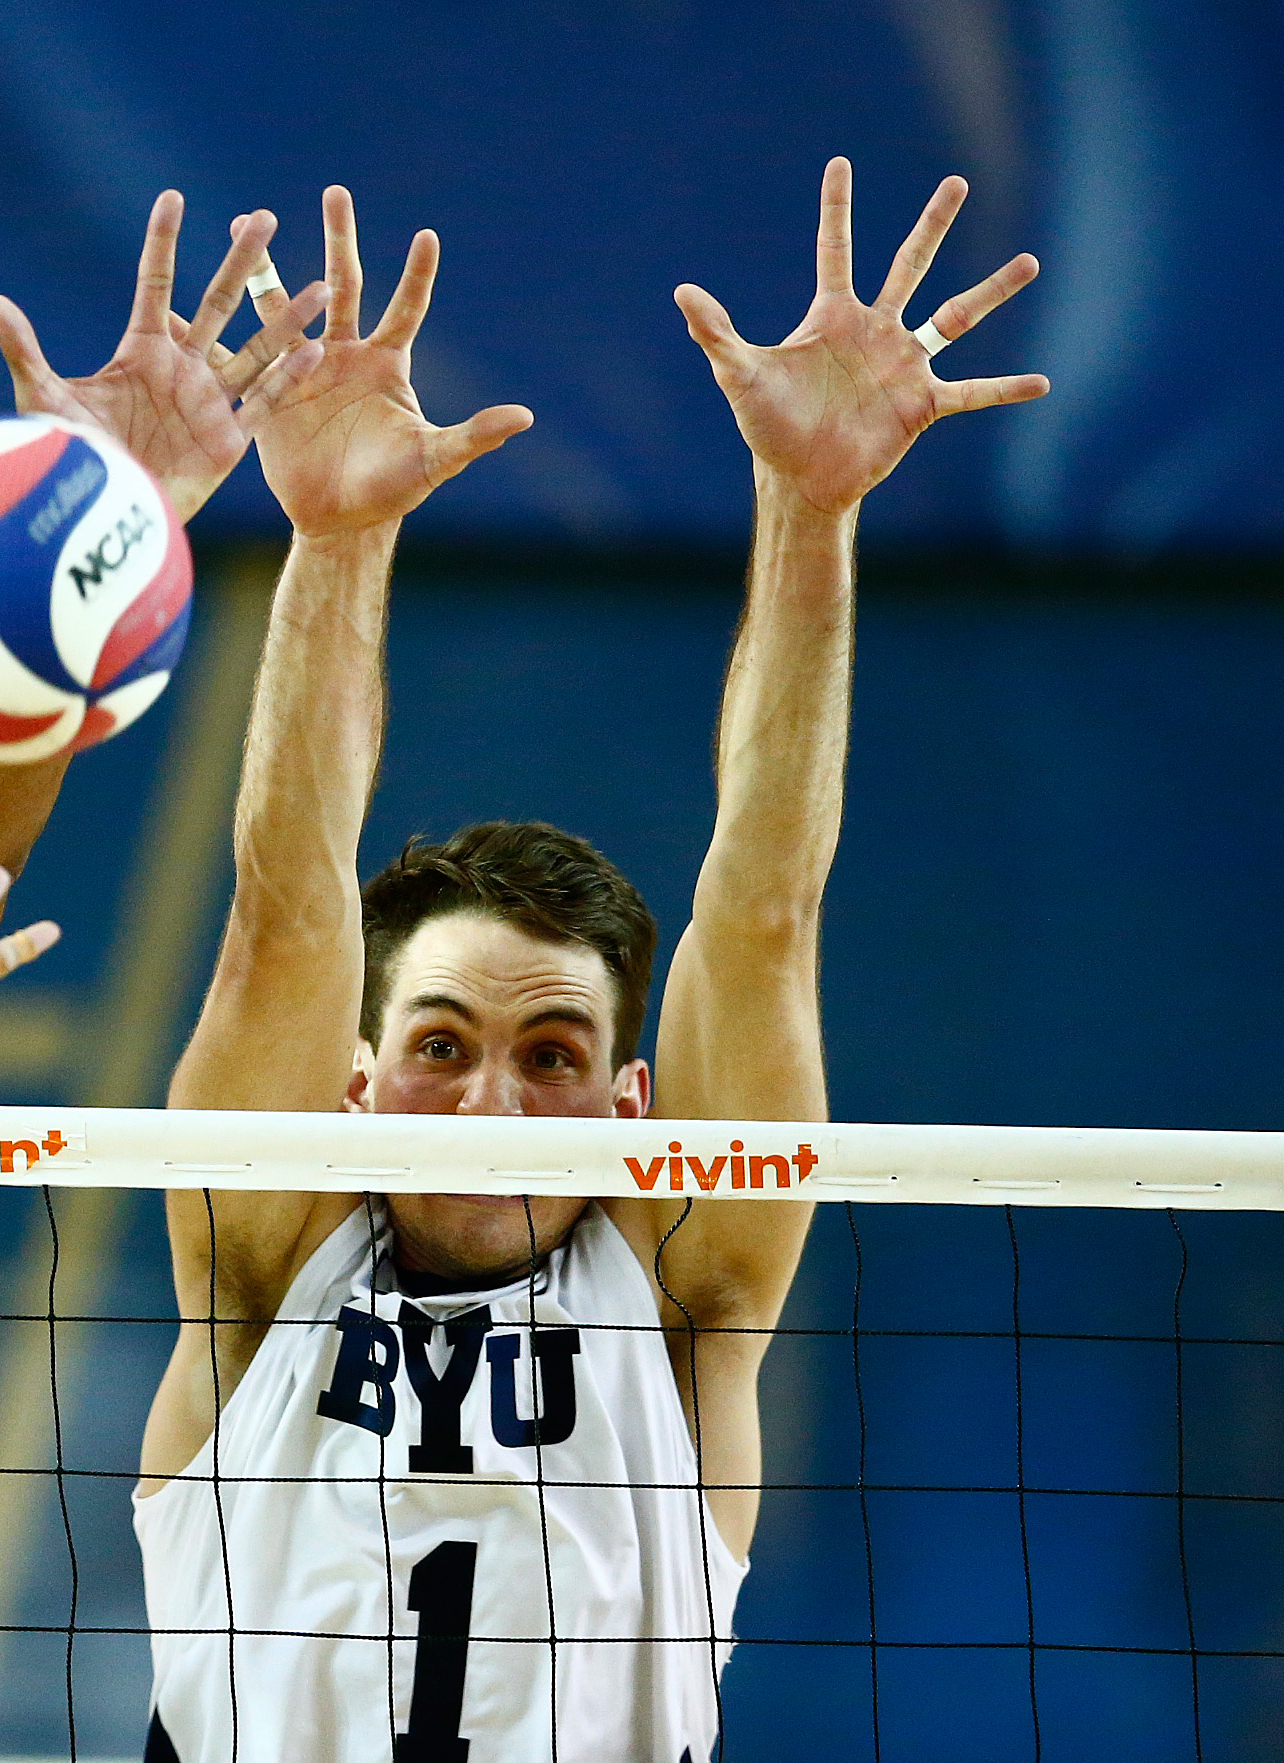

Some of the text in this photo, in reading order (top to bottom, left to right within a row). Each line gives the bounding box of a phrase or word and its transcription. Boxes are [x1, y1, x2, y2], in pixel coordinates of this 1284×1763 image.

[623, 1140, 818, 1190] vivint
[317, 1300, 581, 1474] BYU
[396, 1540, 477, 1763] 1
